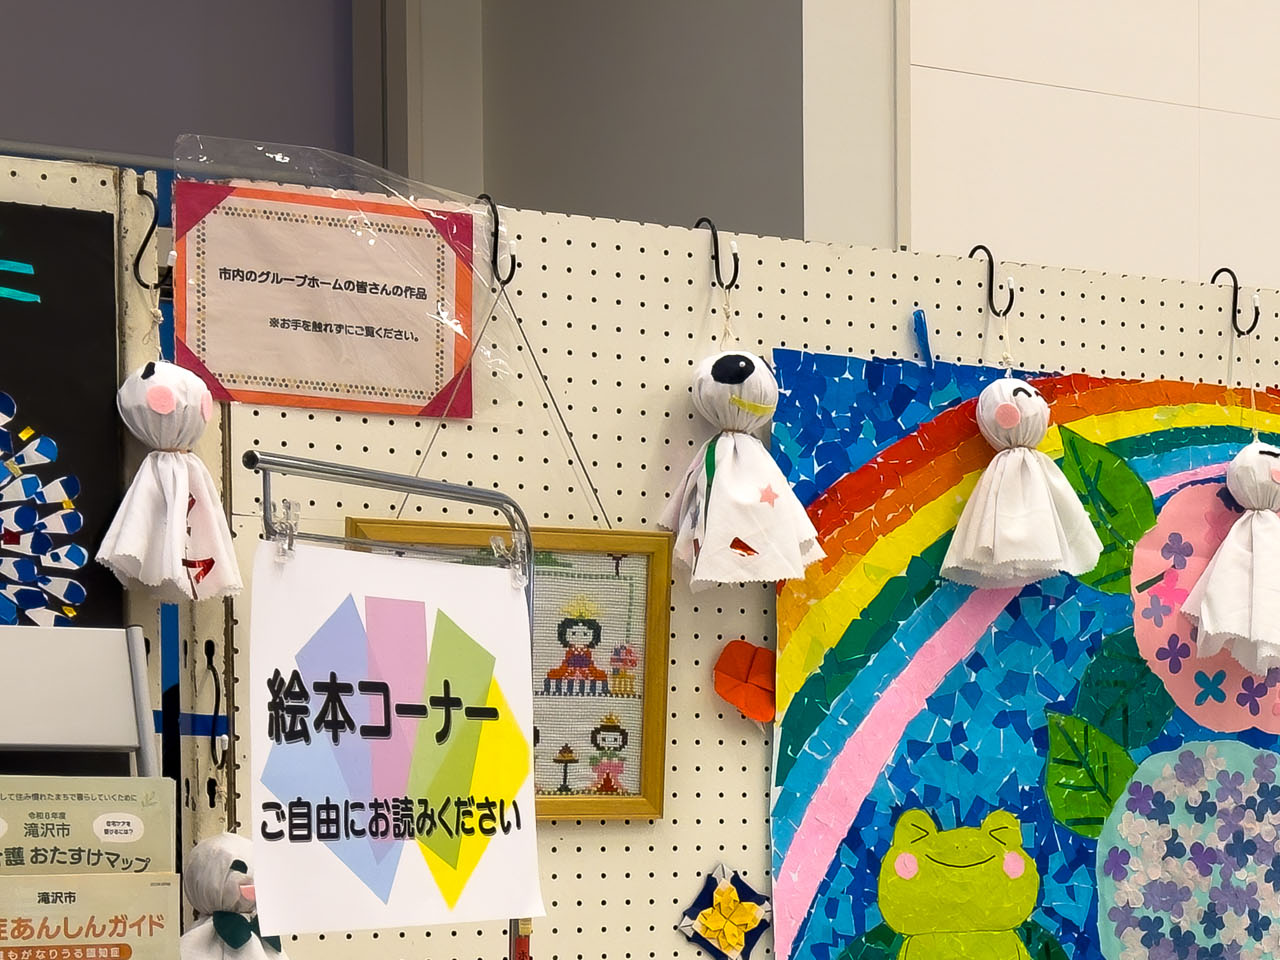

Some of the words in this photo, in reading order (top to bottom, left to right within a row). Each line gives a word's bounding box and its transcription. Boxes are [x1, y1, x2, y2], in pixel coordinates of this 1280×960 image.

[219, 266, 428, 301] 市内のグループホームの皆さんの作品
[266, 667, 500, 746] 絵本コーナー
[23, 822, 71, 838] 滝沢市
[260, 795, 522, 842] ご自由にお読みください
[30, 845, 152, 873] おたすけマップ
[37, 891, 77, 905] 滝沢市
